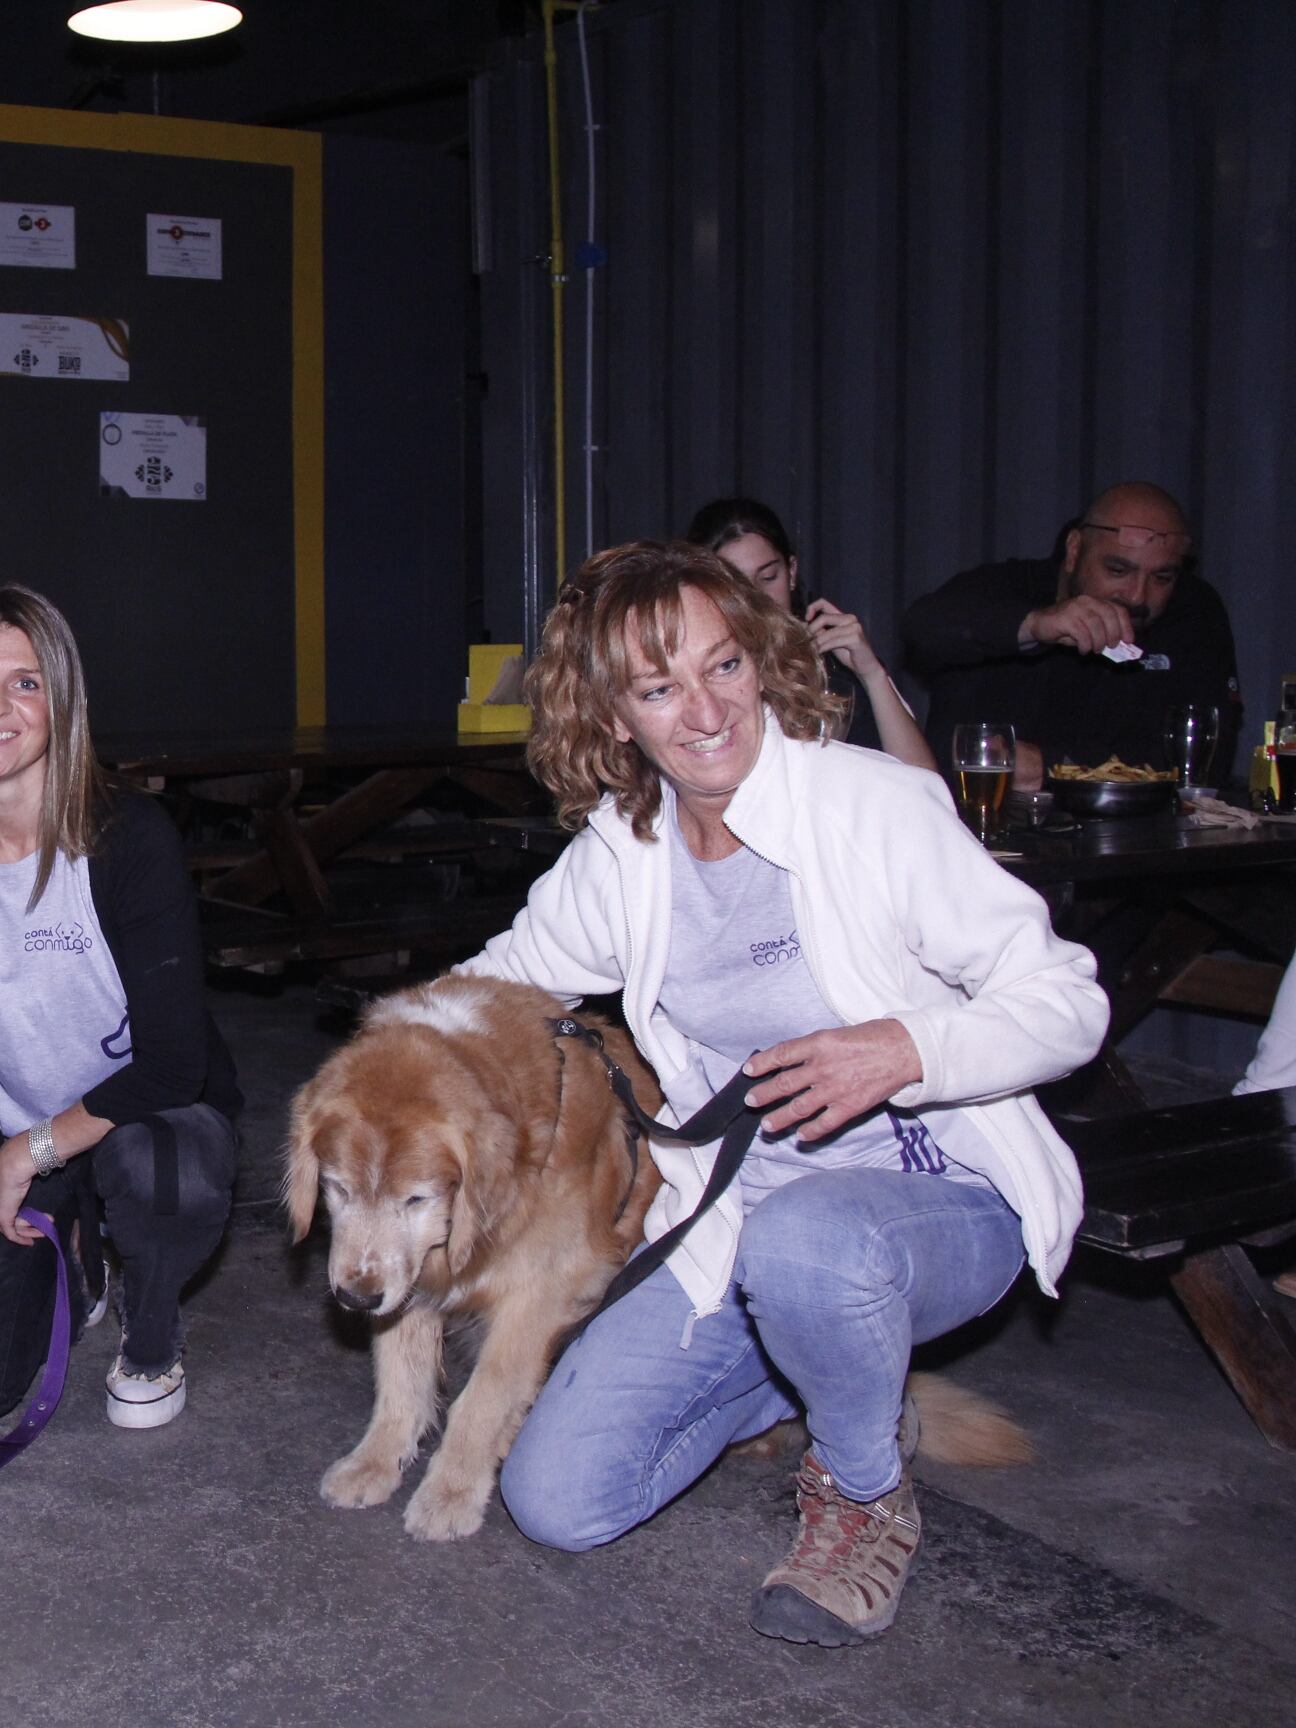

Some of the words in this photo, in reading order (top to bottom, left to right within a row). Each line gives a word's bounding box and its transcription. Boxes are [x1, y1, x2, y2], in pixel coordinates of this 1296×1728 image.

[24, 927, 53, 940] contá
[24, 937, 93, 955] conmigo
[750, 935, 787, 952] contá
[753, 945, 801, 966] conm
